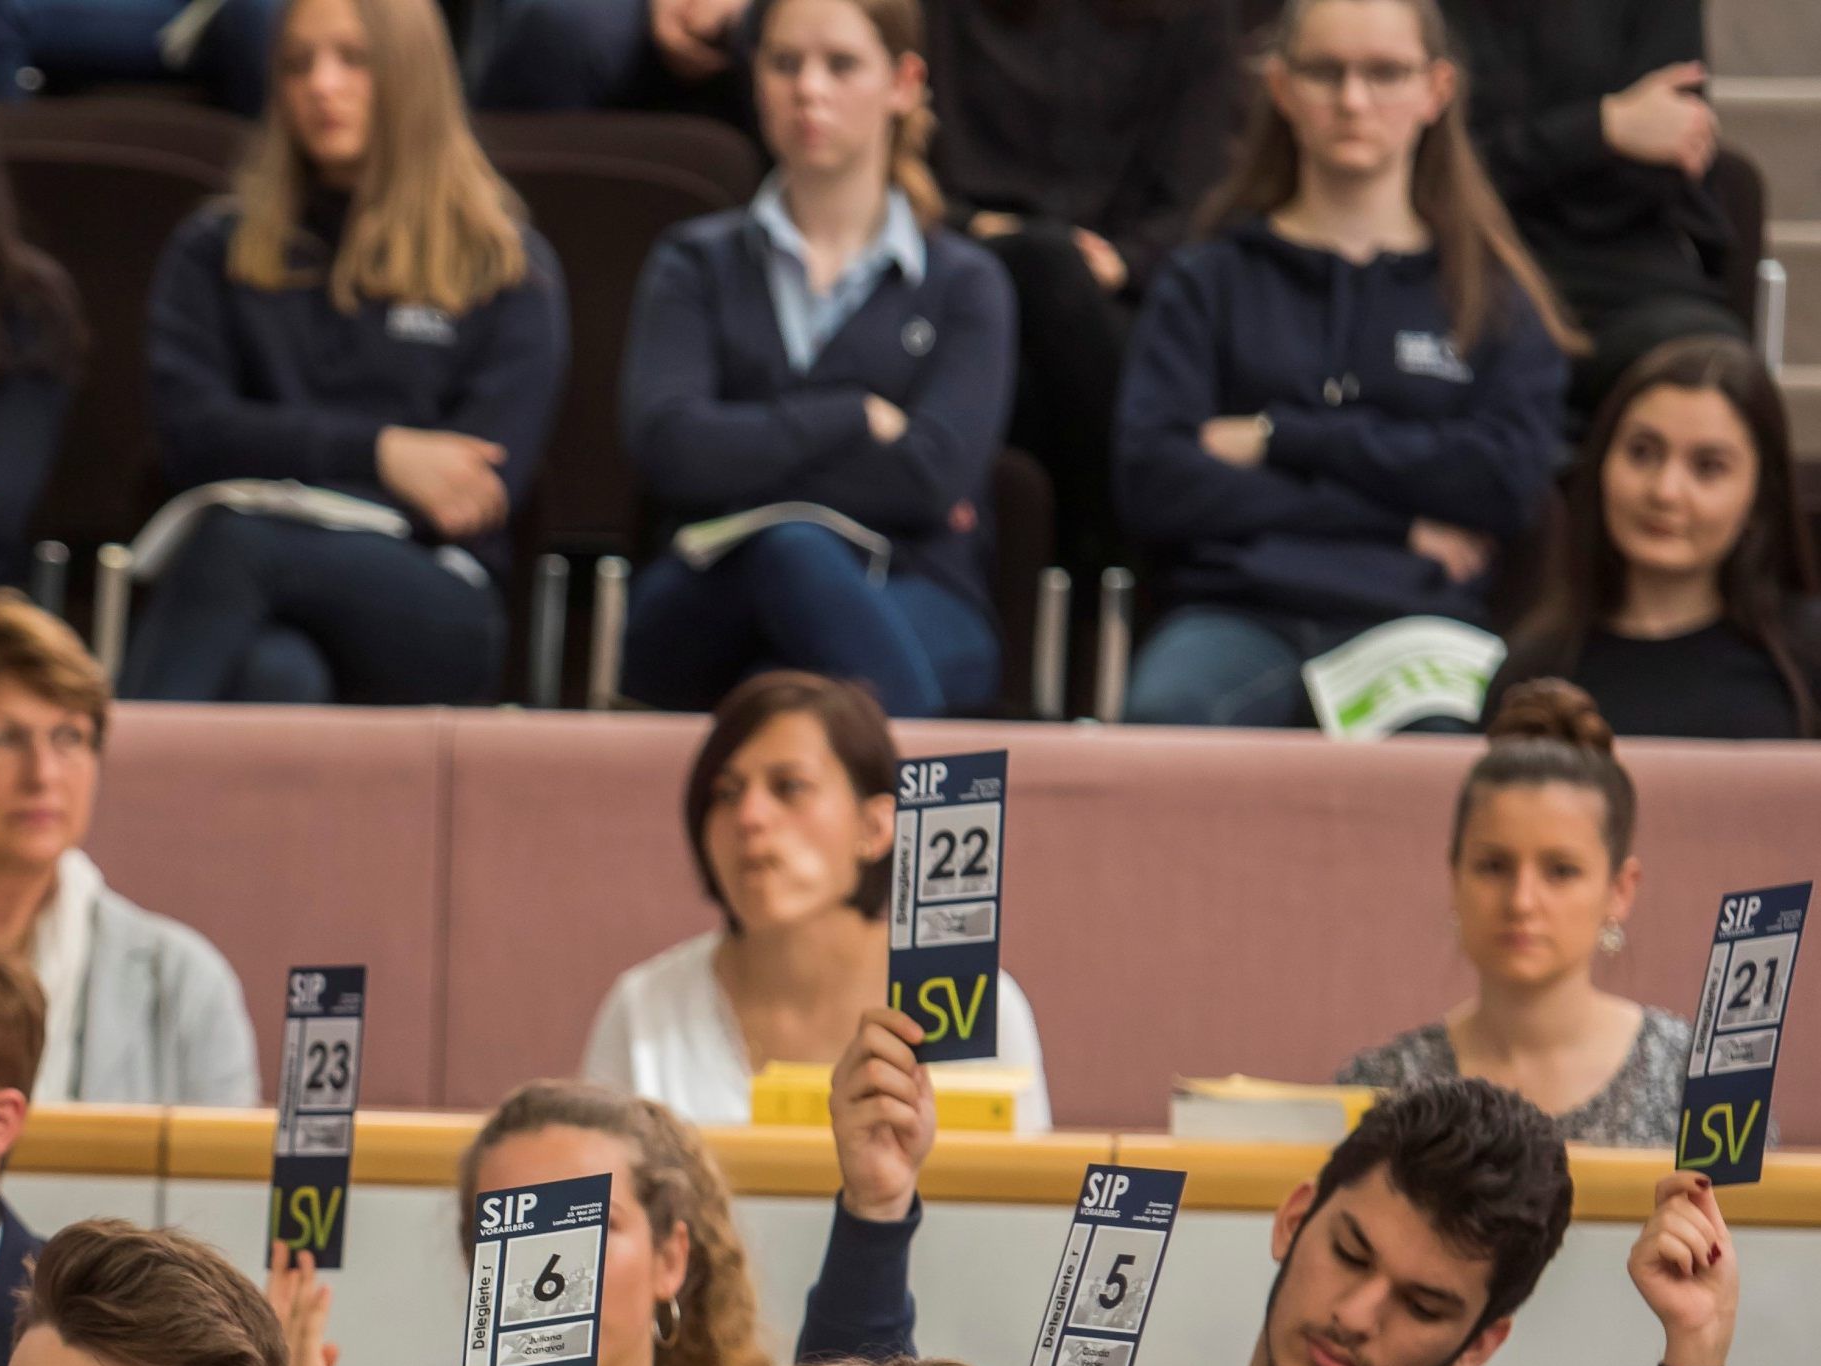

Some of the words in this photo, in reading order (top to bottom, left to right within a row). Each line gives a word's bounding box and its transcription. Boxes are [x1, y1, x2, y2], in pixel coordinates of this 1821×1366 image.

[900, 762, 948, 798] SIP
[928, 826, 989, 879] 22
[1721, 896, 1762, 932] SIP
[1727, 957, 1779, 1010] 21
[306, 1041, 350, 1090] 23
[1679, 1100, 1761, 1169] LSV
[481, 1193, 538, 1228] SIP
[1083, 1172, 1129, 1207] SIP
[272, 1186, 342, 1250] LSV
[479, 1221, 535, 1236] VORARLBERG
[533, 1253, 565, 1302] 6
[1098, 1254, 1136, 1310] 5
